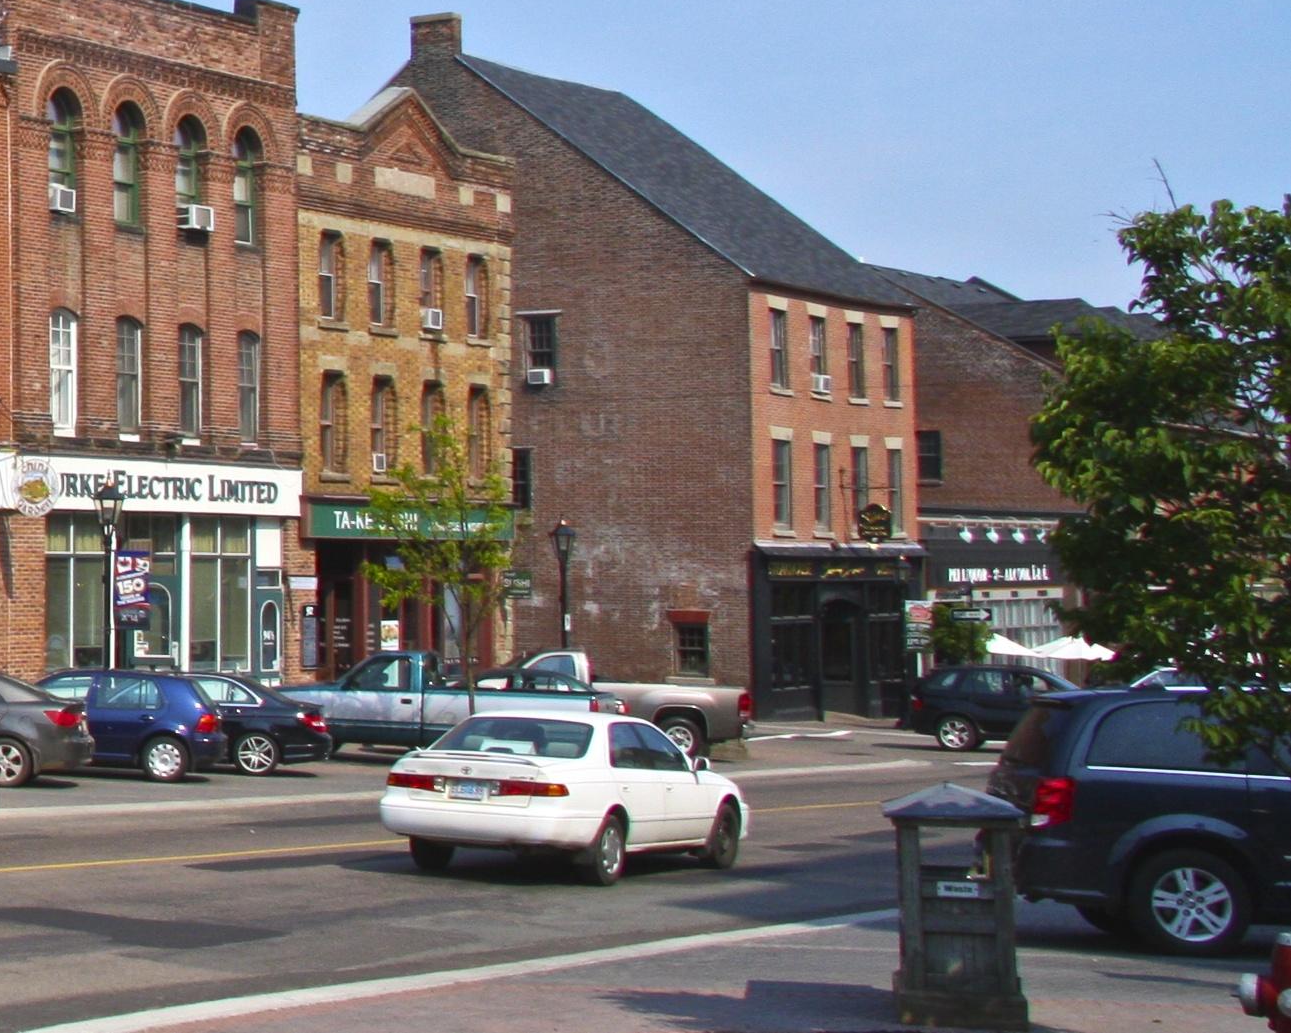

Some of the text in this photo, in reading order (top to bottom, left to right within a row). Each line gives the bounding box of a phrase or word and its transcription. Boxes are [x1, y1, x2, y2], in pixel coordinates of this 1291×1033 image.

[112, 469, 202, 501] ELECTRIC
[207, 474, 278, 505] LIMITED
[116, 578, 146, 595] 150
